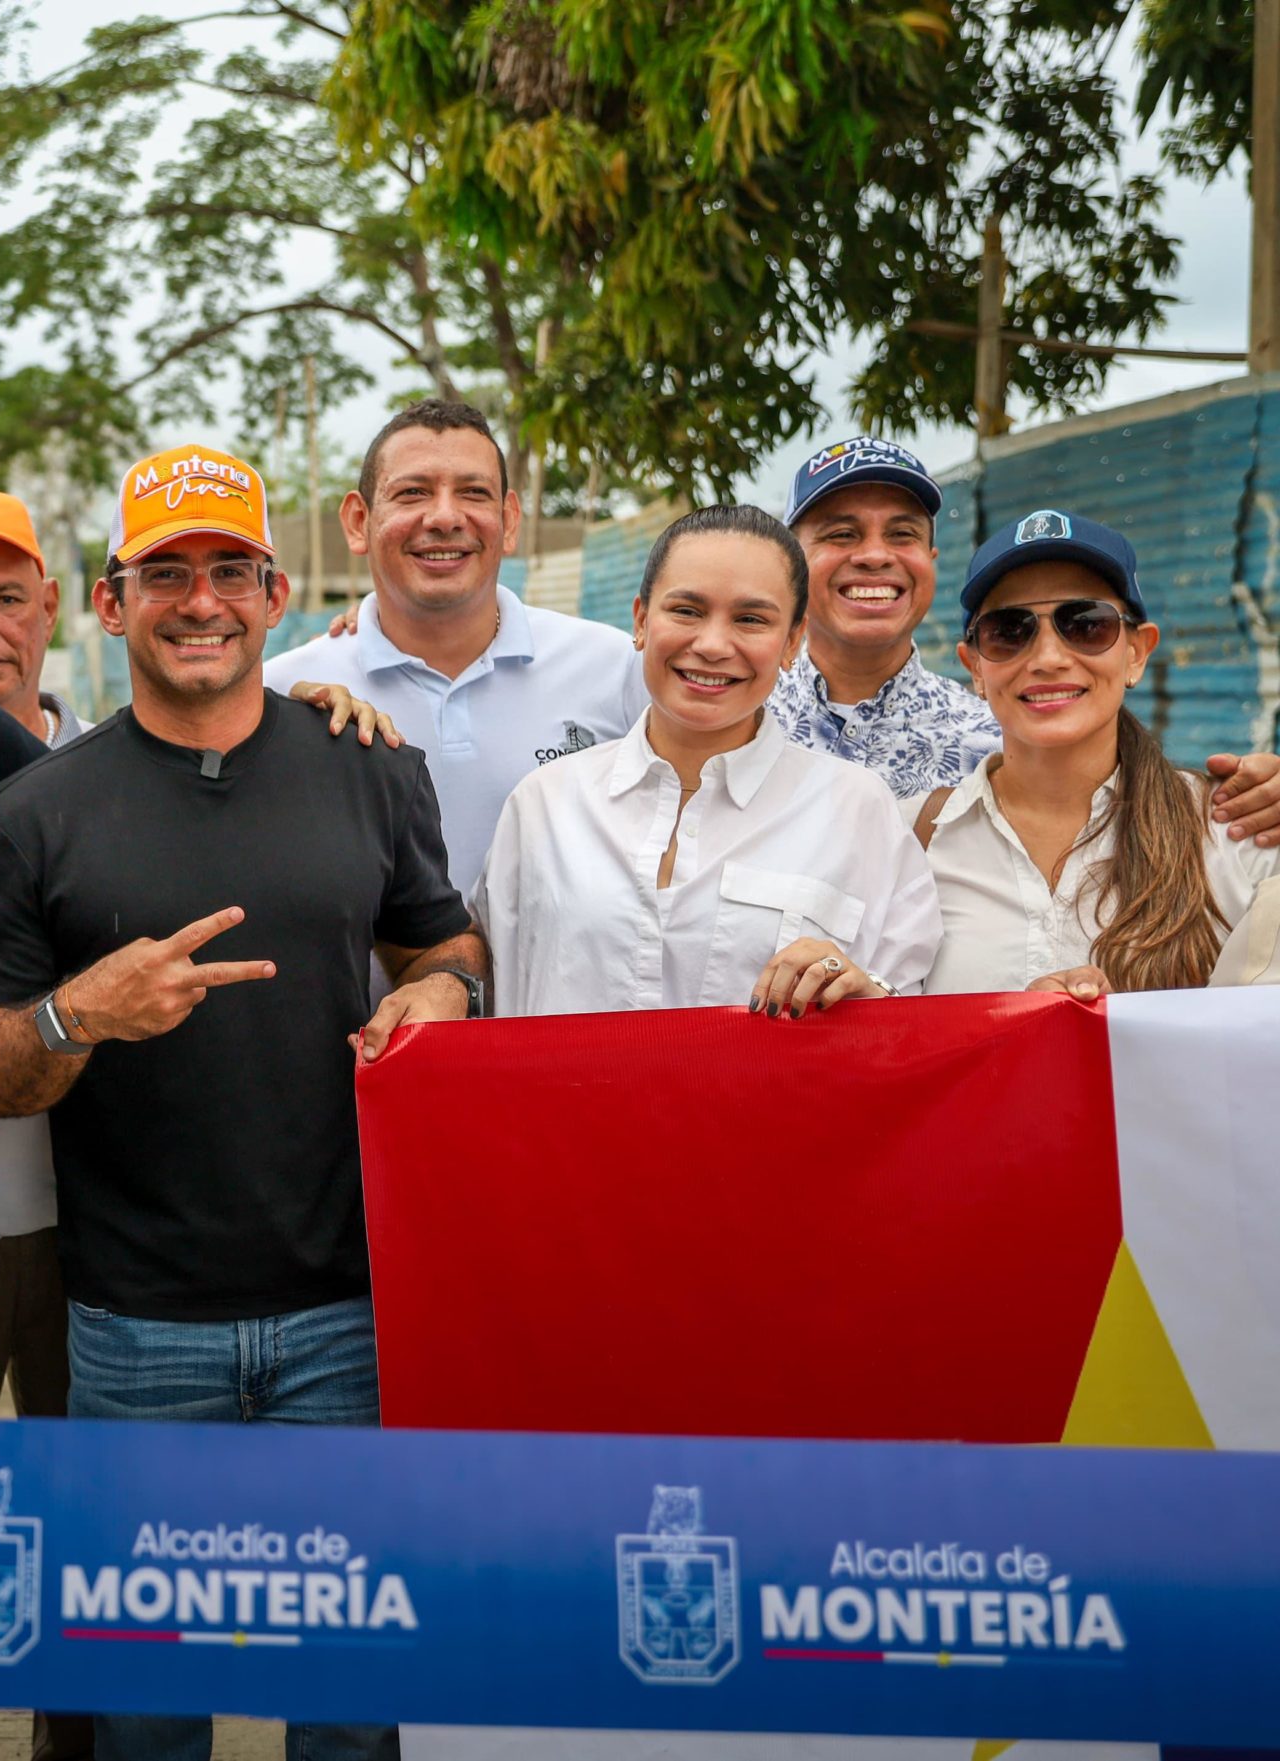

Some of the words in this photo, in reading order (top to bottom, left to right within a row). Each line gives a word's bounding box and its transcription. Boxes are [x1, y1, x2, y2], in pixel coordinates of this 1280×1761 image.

[132, 1521, 288, 1562] Alcaldía
[296, 1526, 349, 1565] de
[830, 1541, 987, 1582] Alcaldía
[996, 1546, 1051, 1584] de
[61, 1556, 419, 1630] MONTERÍA
[760, 1574, 1126, 1652] MONTERÍA
